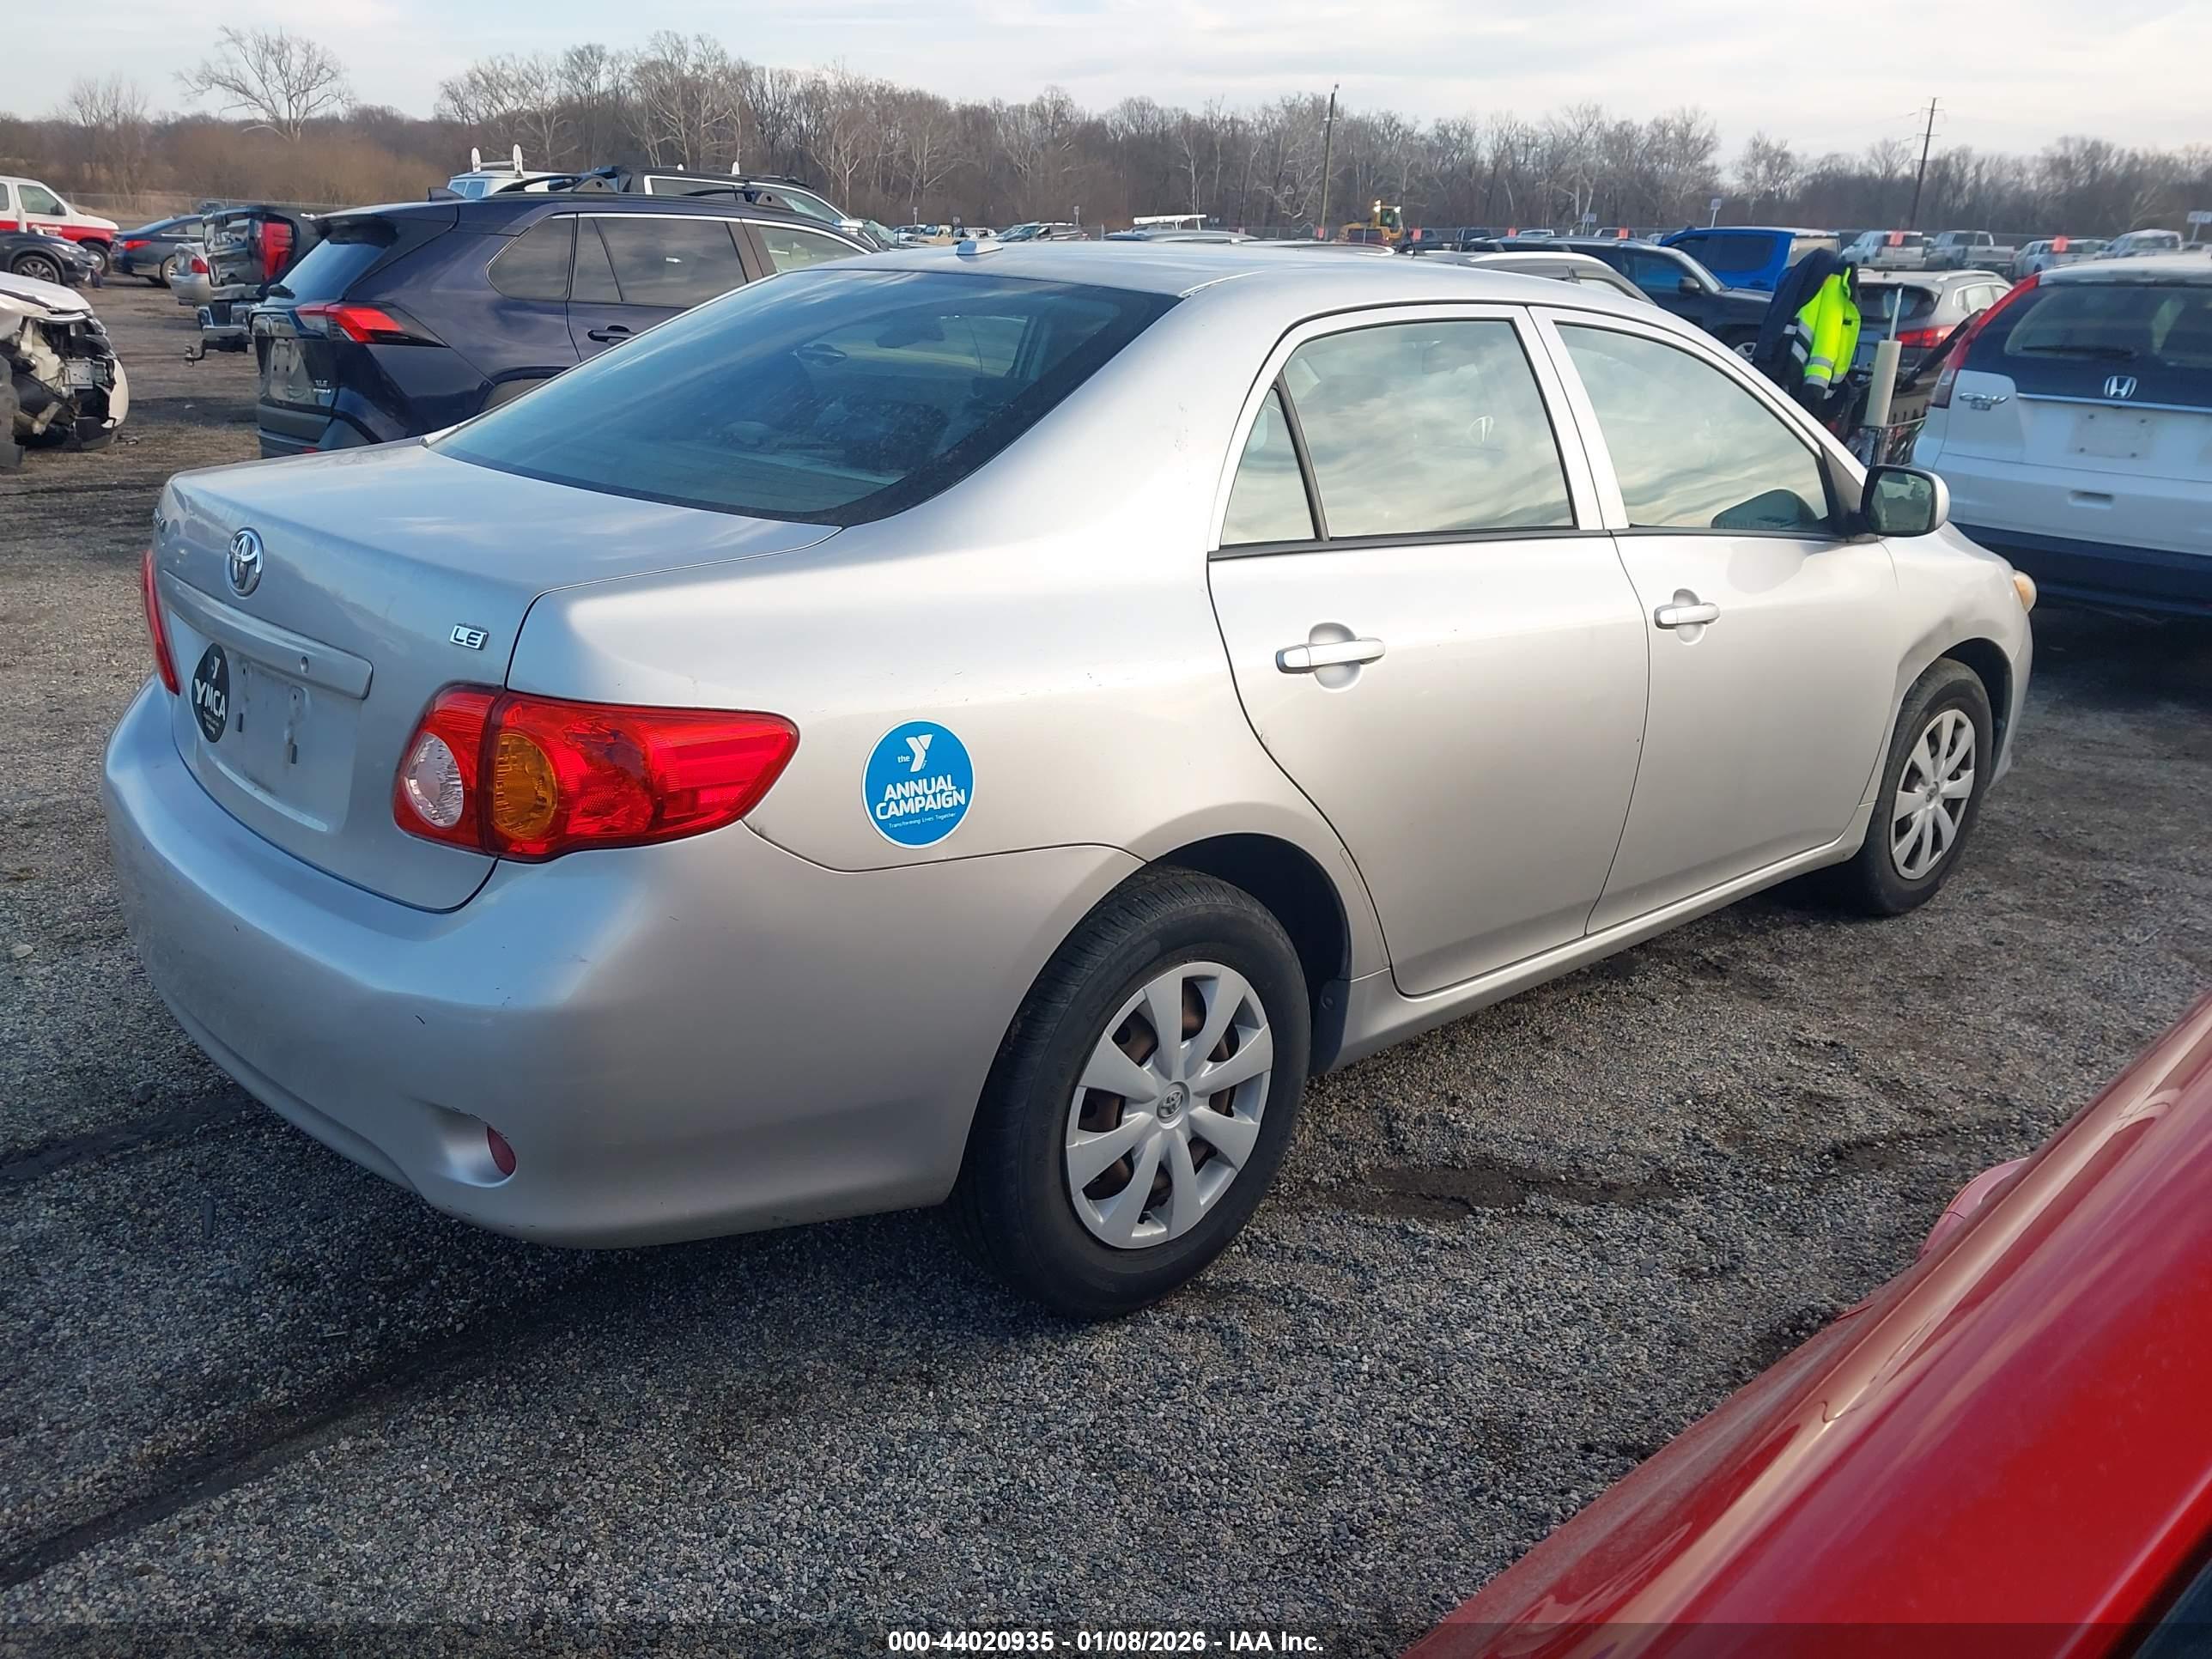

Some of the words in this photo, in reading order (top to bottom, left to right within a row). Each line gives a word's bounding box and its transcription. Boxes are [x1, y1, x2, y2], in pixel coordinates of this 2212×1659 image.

[453, 626, 483, 647] LE
[194, 678, 226, 721] YMCA
[897, 755, 910, 763] the
[884, 774, 957, 802] ANNUAL
[876, 788, 966, 820] CAMPAIGN
